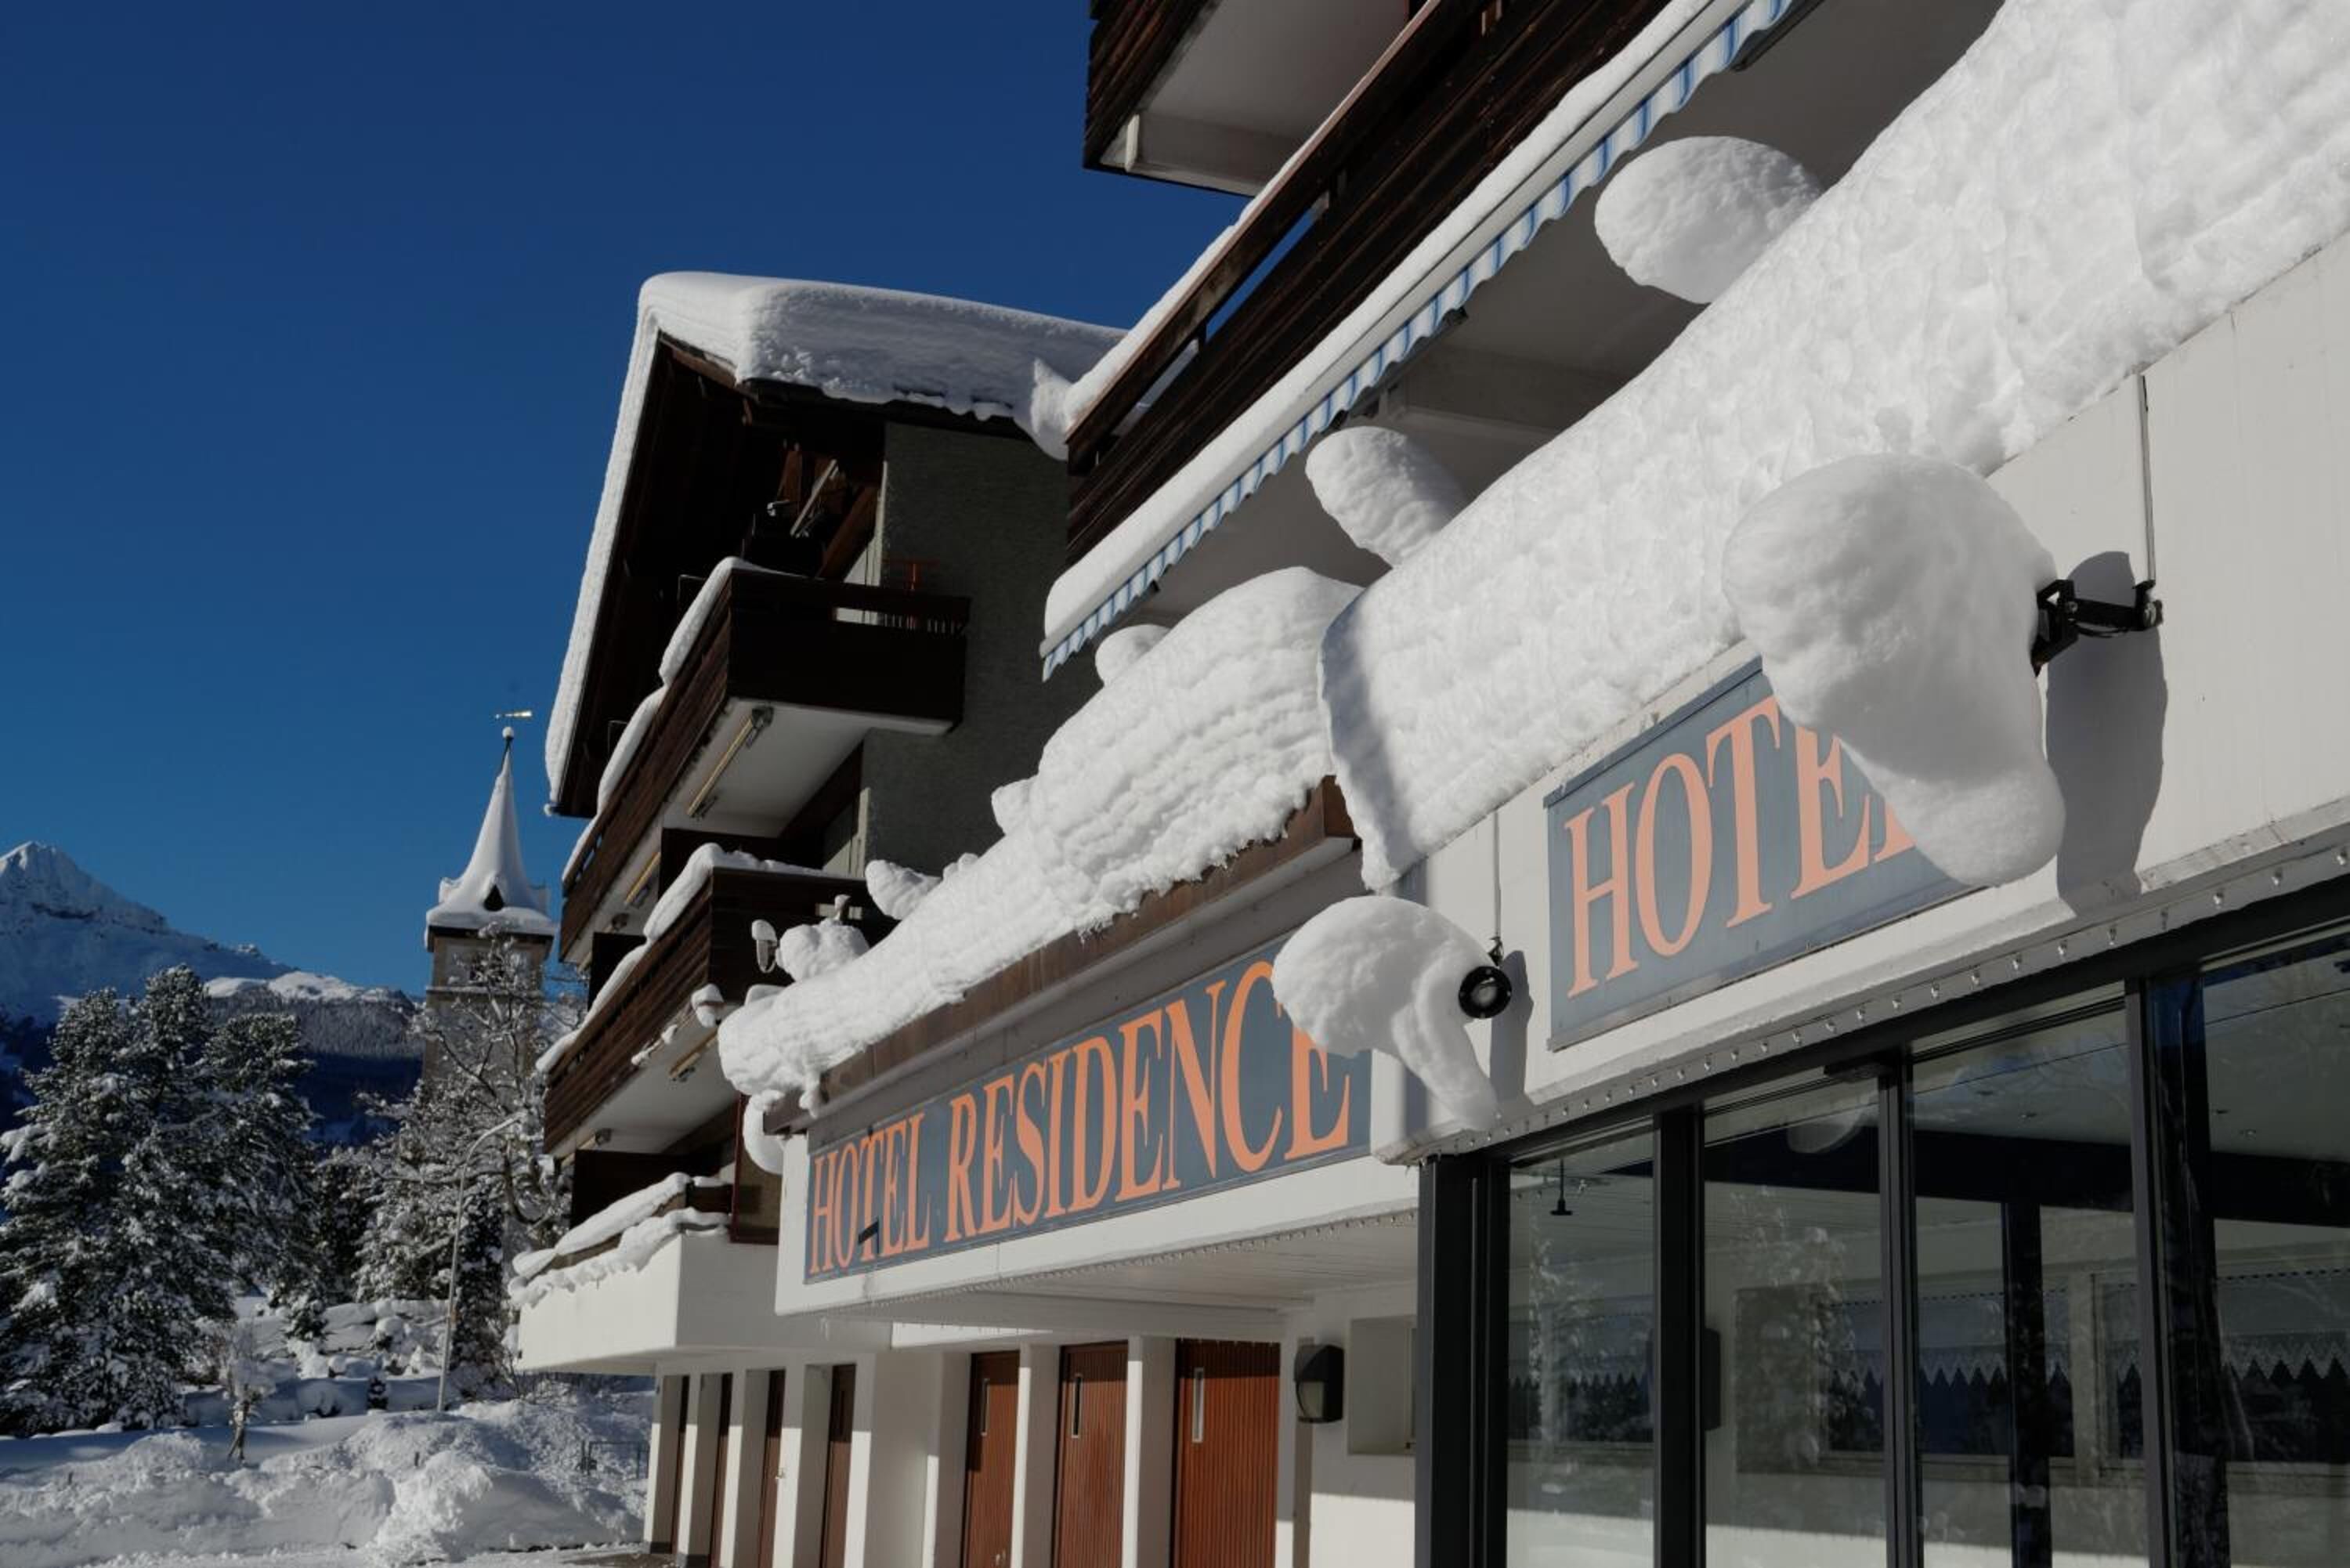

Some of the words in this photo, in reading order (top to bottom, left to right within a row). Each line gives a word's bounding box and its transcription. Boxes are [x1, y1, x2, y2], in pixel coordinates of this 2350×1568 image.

[1564, 695, 1916, 999] HOTE
[809, 1111, 930, 1274] HOTEL
[943, 960, 1350, 1244] RESIDENCE
